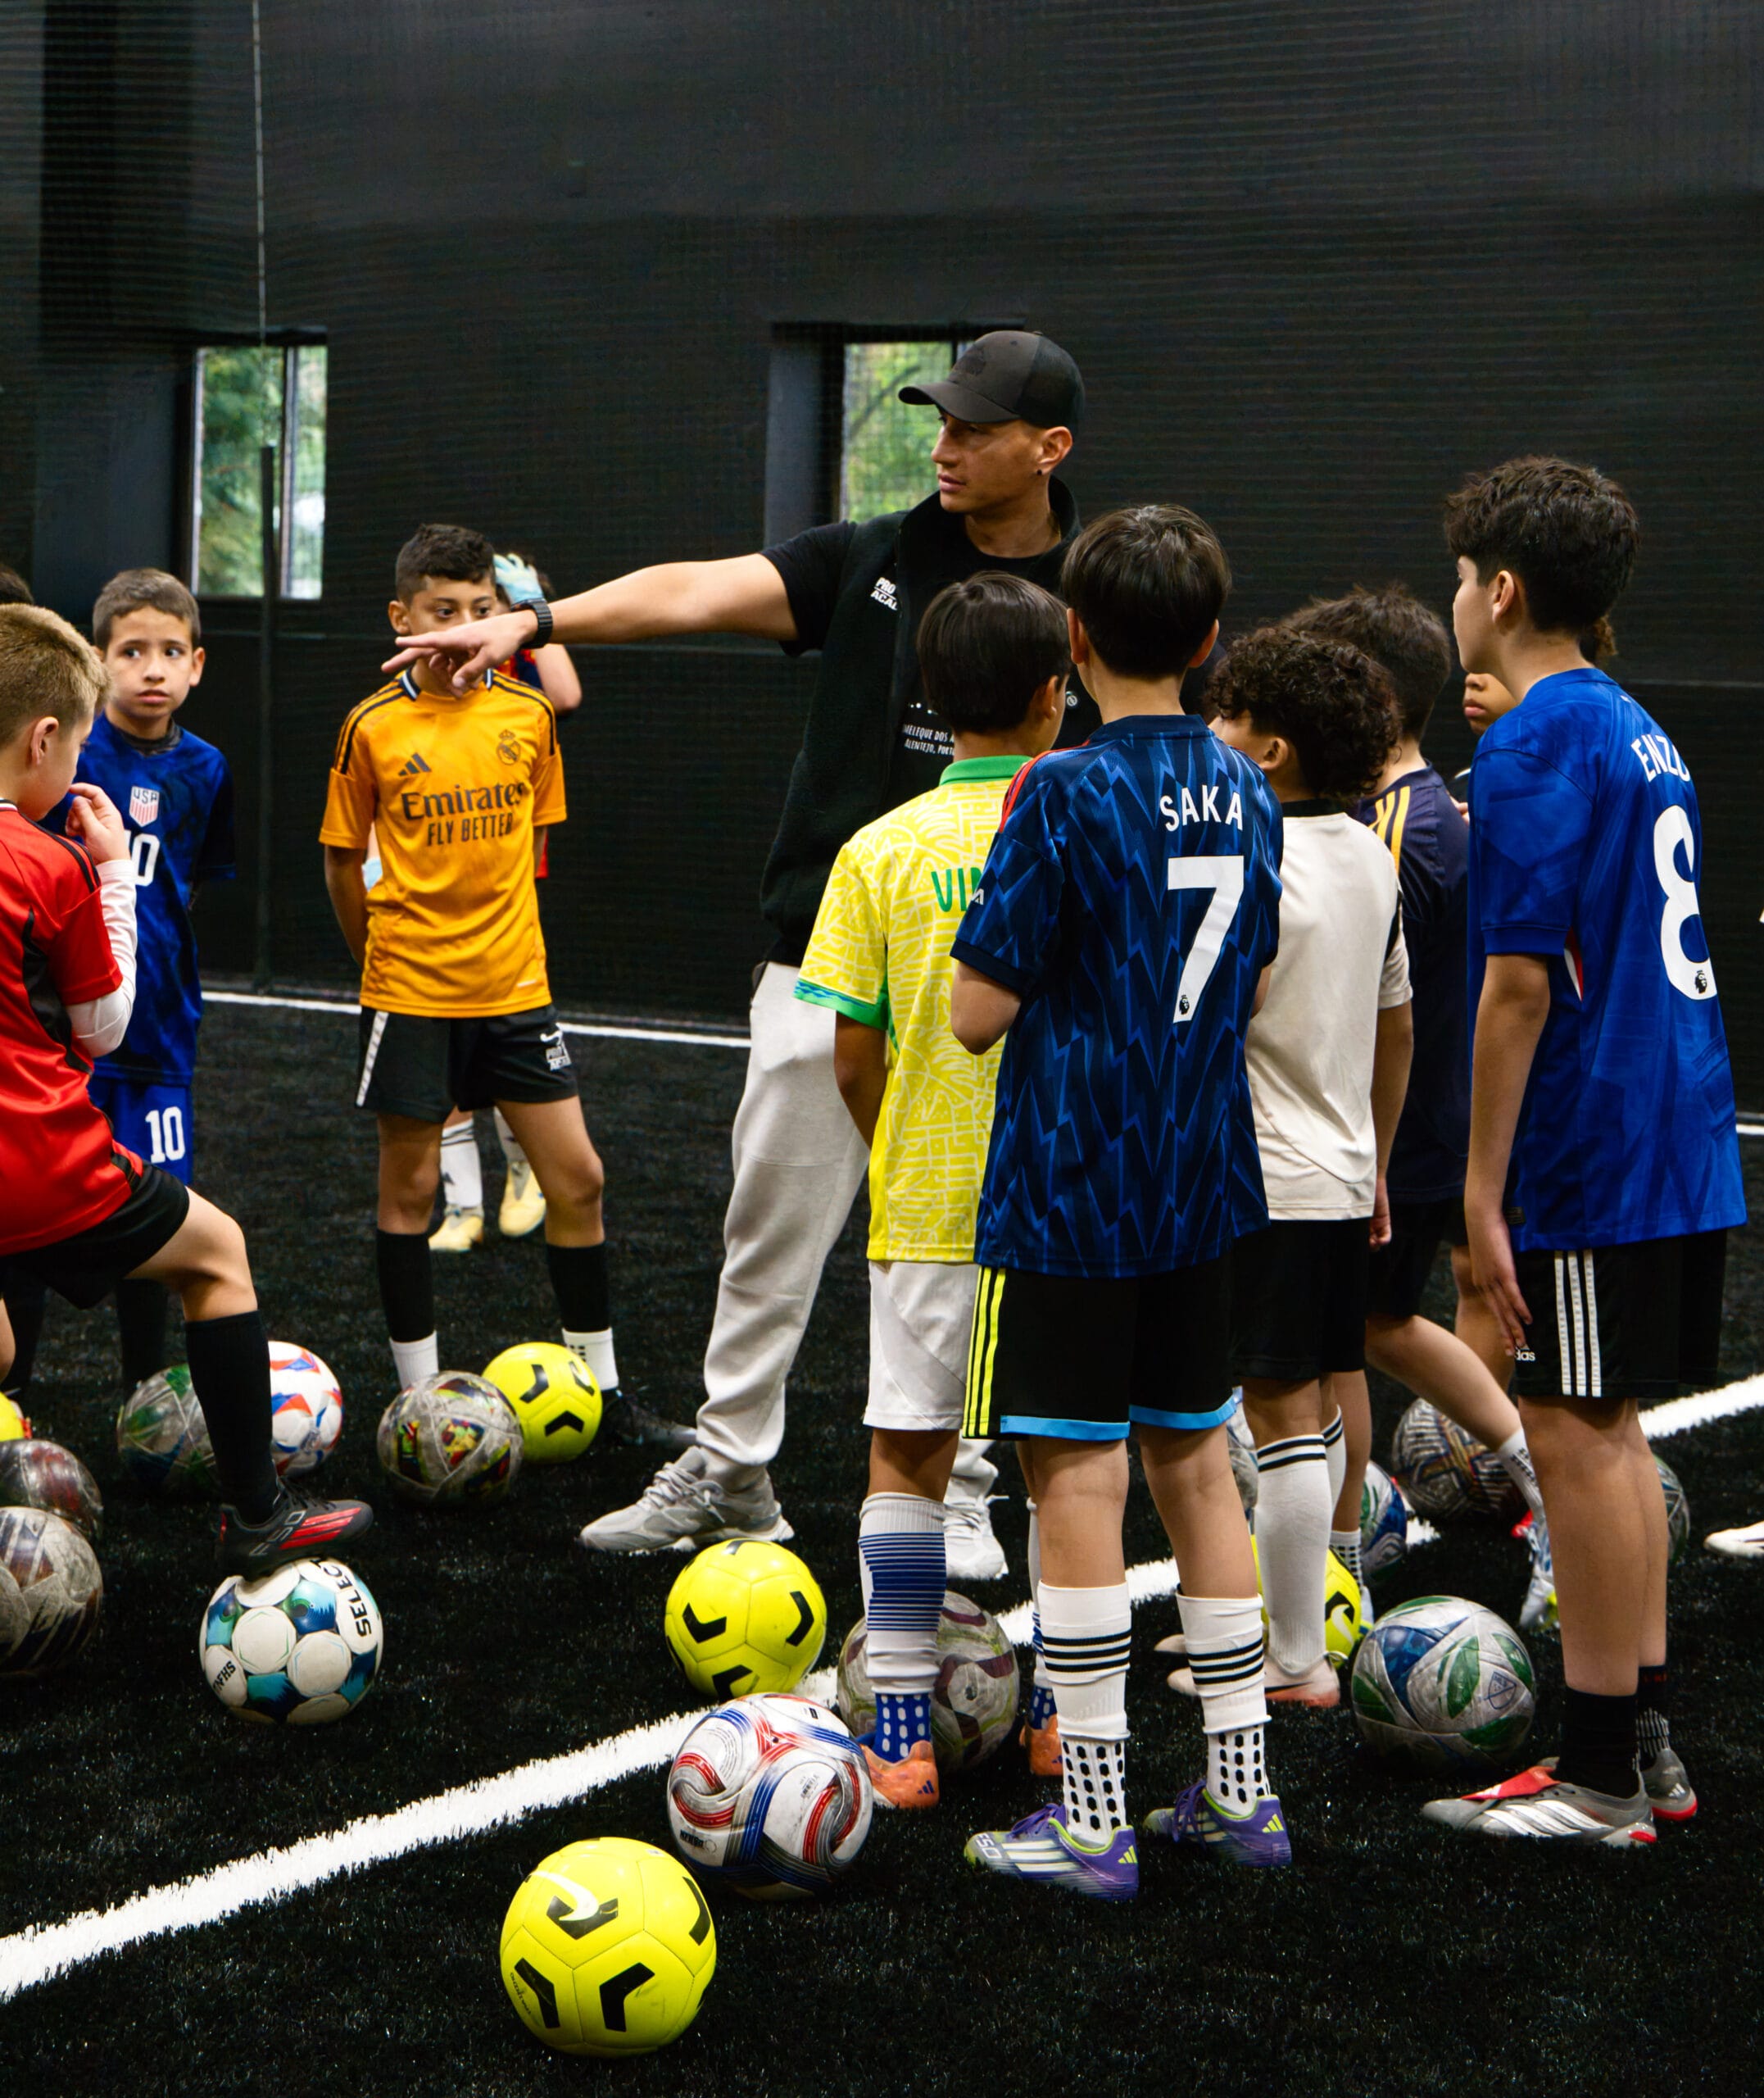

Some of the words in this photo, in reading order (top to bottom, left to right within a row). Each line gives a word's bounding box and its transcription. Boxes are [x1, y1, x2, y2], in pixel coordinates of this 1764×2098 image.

[427, 820, 455, 847] FLY
[460, 812, 514, 842] BETTER
[1159, 784, 1244, 833] SAKA
[1653, 805, 1718, 1001] 8
[1168, 855, 1245, 1024] 7
[145, 1106, 186, 1164] 10
